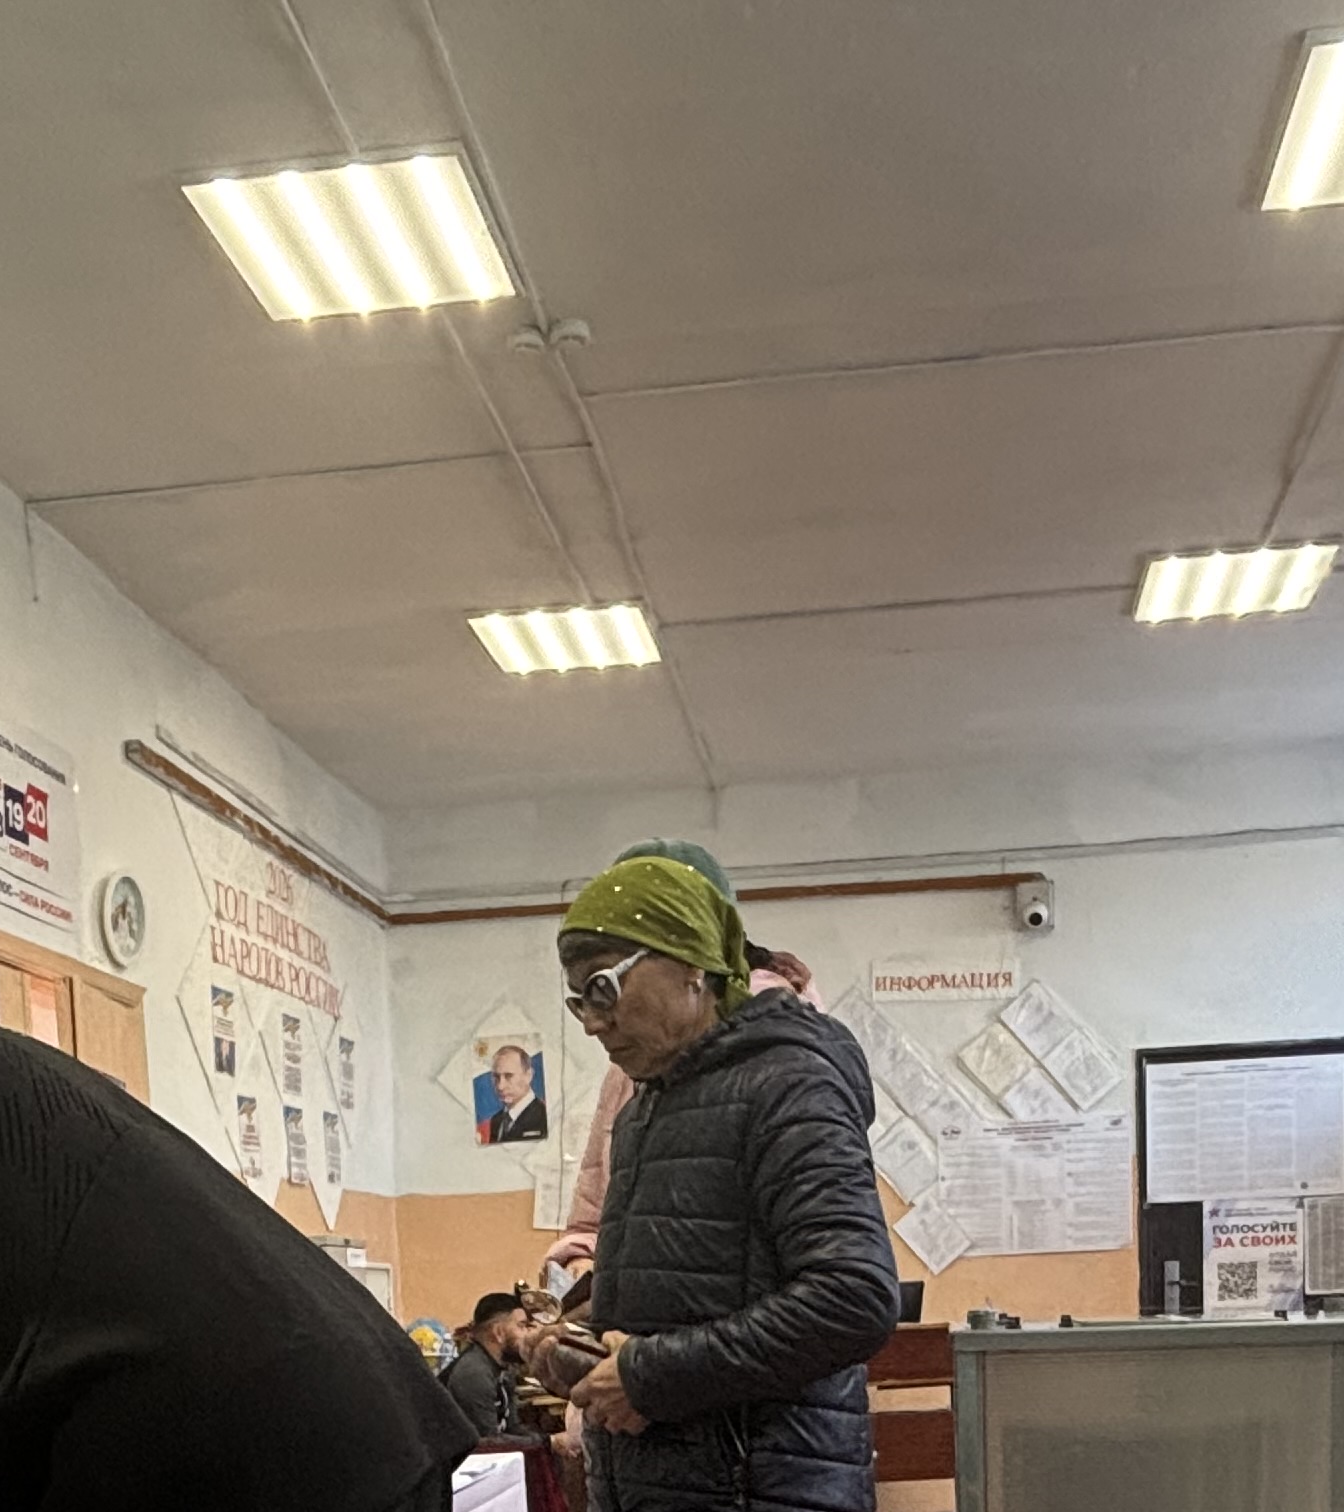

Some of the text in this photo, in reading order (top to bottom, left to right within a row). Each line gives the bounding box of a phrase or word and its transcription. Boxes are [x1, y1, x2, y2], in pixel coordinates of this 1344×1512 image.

[7, 799, 24, 831] 19
[27, 795, 46, 829] 20
[213, 879, 331, 973] ГОД ЕДИНСТВА
[210, 925, 285, 992] НАРОДОВ
[874, 971, 1013, 992] ИНФОРМАЦИЯ
[1212, 1220, 1297, 1235] ГОЛОСУЙТЕ
[1212, 1234, 1298, 1248] ЗА СВОИХ
